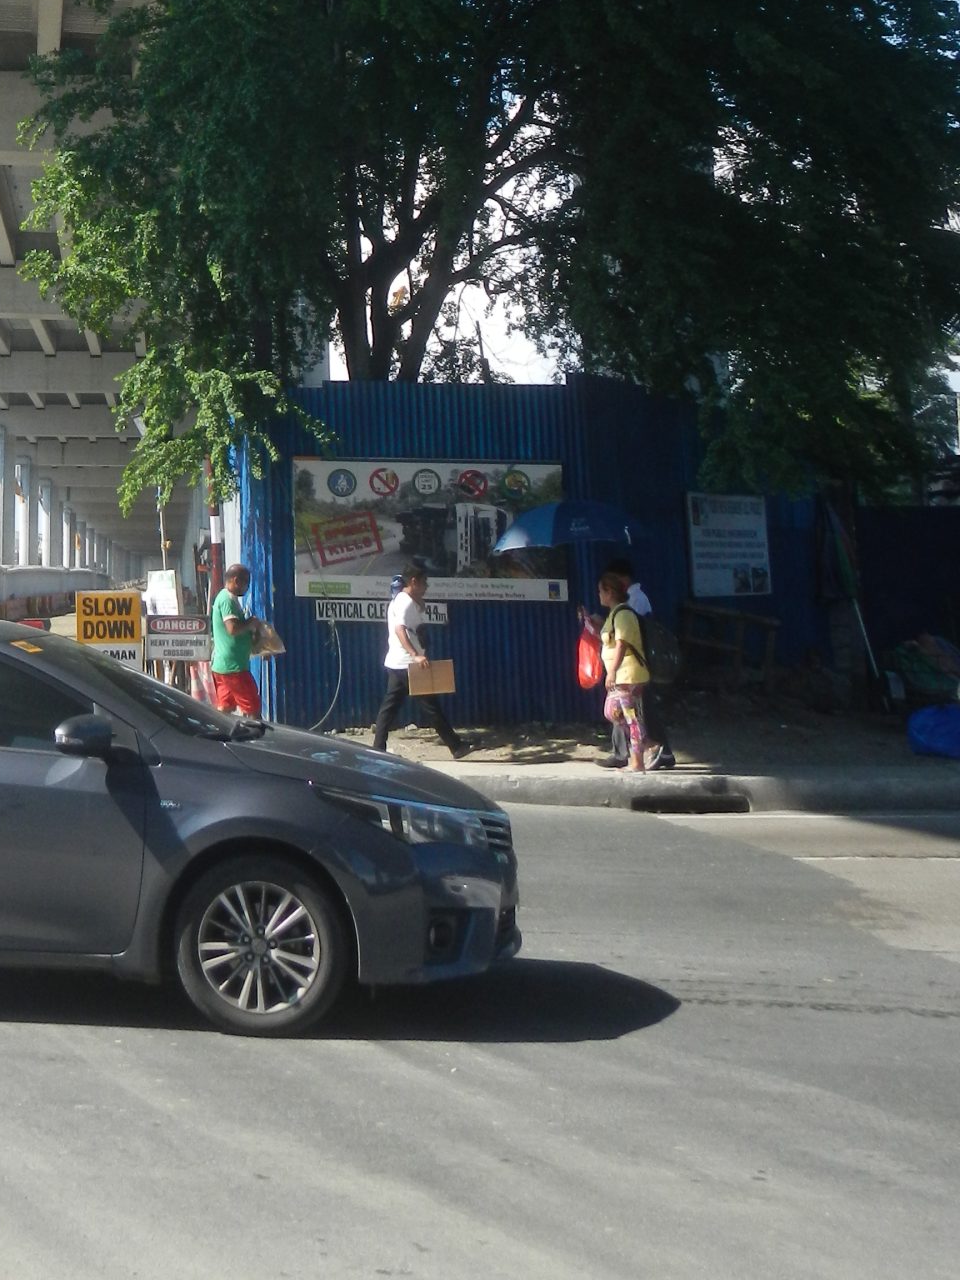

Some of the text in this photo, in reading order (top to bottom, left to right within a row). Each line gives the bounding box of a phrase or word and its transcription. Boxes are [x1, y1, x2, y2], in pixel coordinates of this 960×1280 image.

[82, 597, 132, 616] SLOW
[317, 601, 365, 619] VERTICAL
[83, 620, 135, 639] DOWN
[156, 620, 200, 630] DANGER
[150, 639, 207, 647] HEAVY EQUIPMENT
[163, 649, 194, 657] CROSSING
